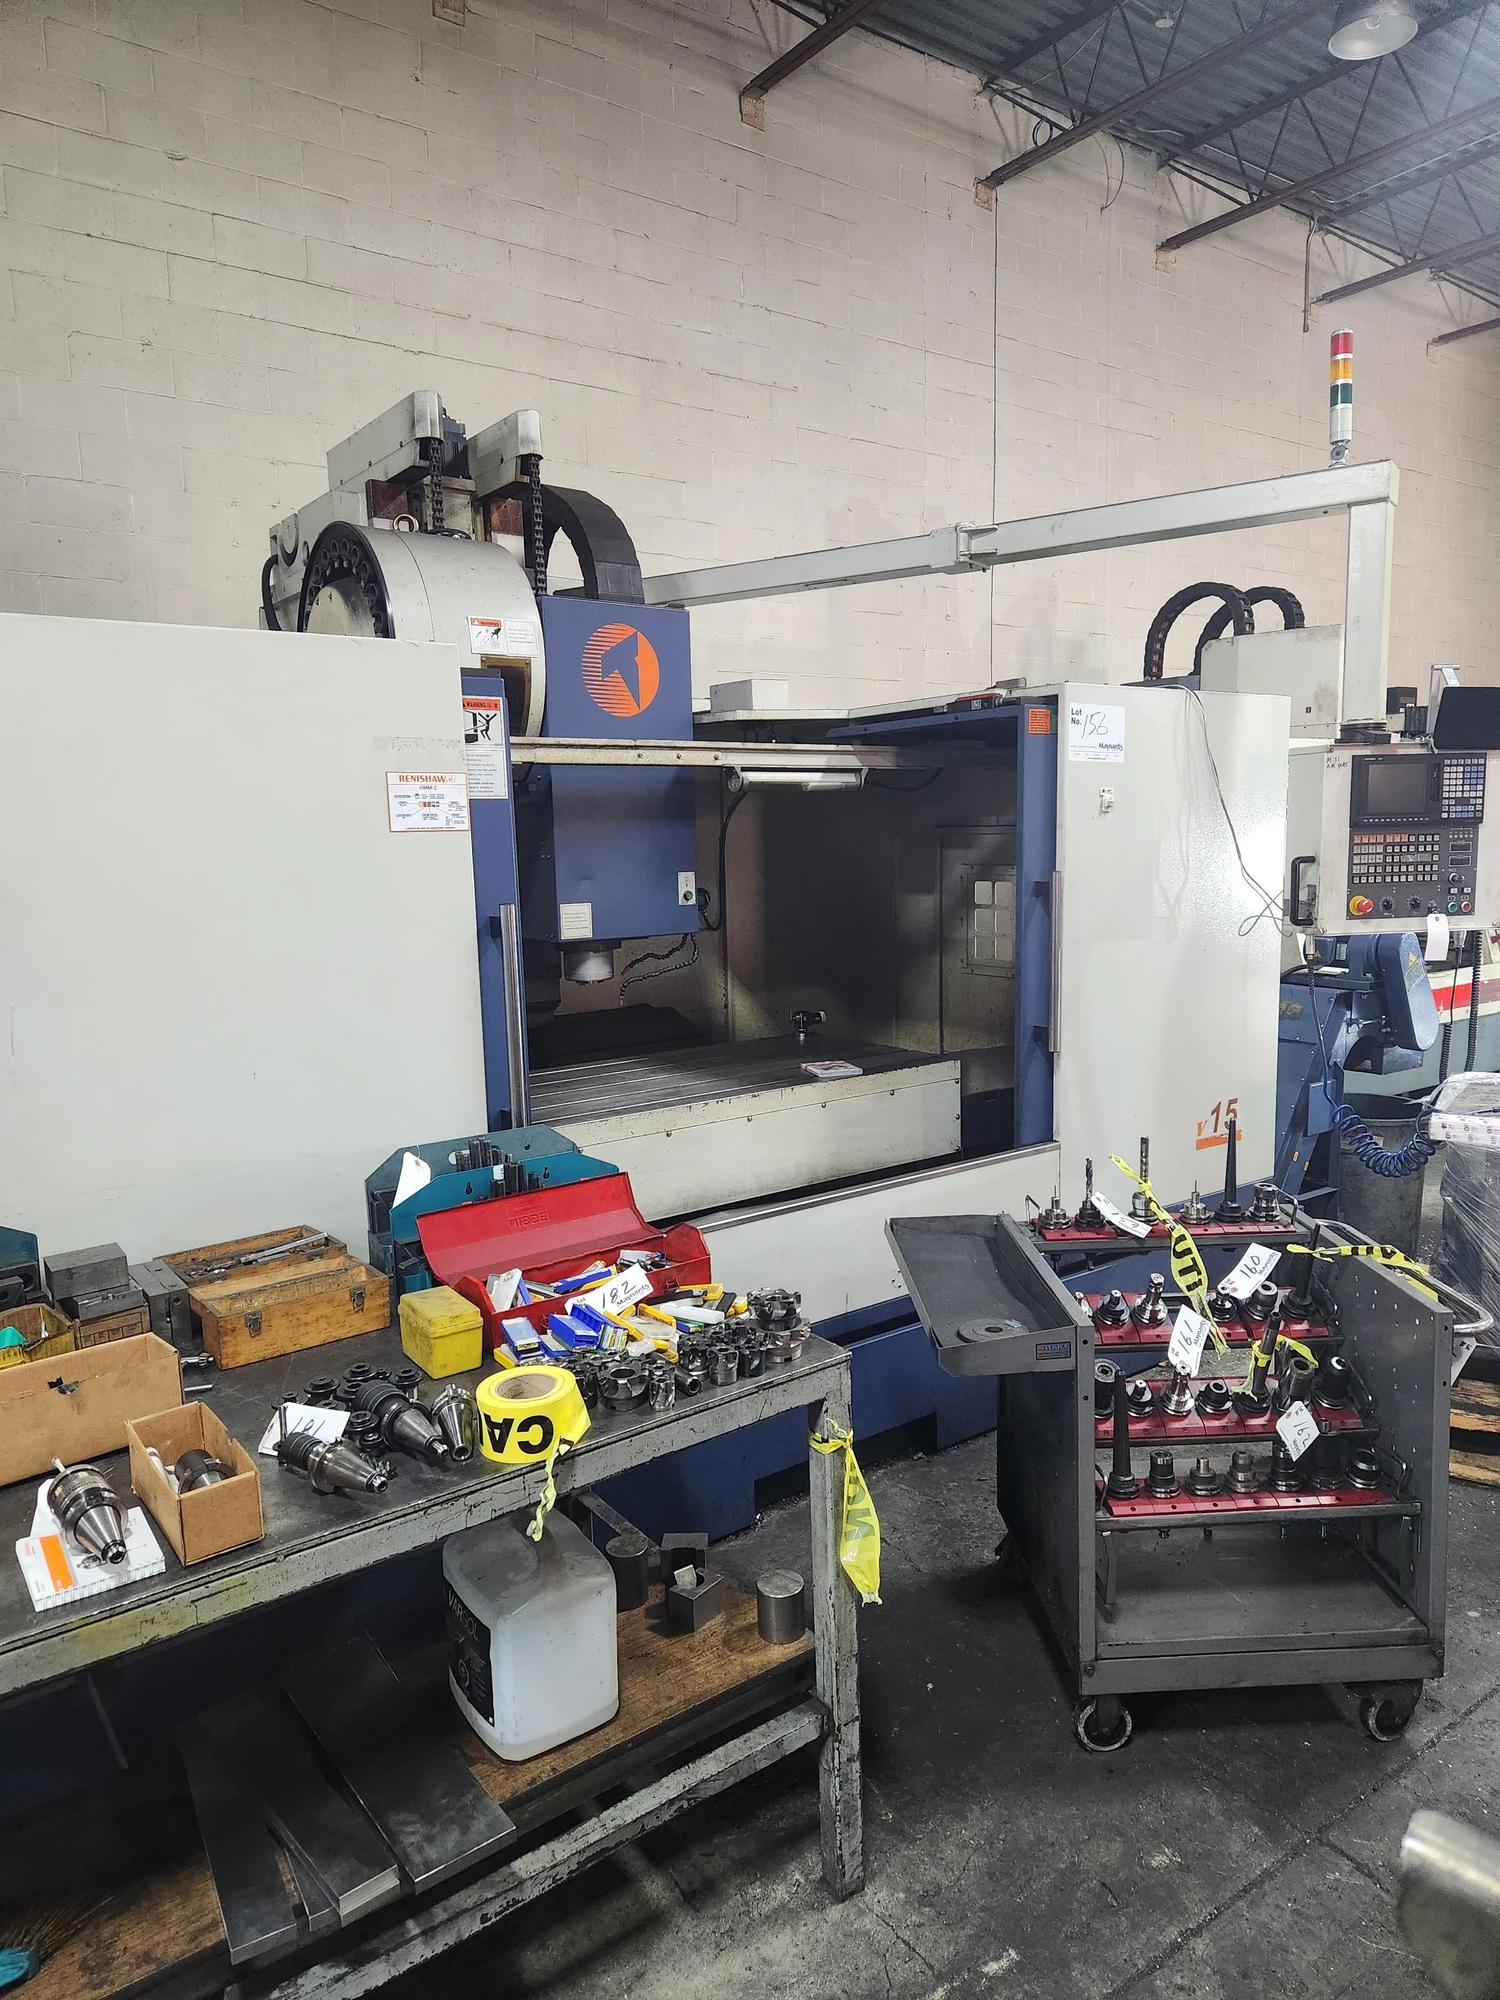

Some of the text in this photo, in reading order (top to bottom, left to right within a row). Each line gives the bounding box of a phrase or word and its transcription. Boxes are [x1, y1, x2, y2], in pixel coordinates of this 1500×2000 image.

[466, 701, 486, 709] WARNING
[1071, 708, 1082, 716] Lot
[1071, 717, 1082, 725] No.
[1081, 711, 1108, 738] 156
[1098, 742, 1123, 751] Maynards
[399, 774, 447, 783] RENISHAW
[1240, 1255, 1261, 1279] 160
[602, 1281, 636, 1309] 182
[616, 1283, 650, 1307] Maynards
[1178, 1319, 1193, 1354] 161
[478, 1408, 555, 1455] CA
[1293, 1420, 1310, 1449] 162
